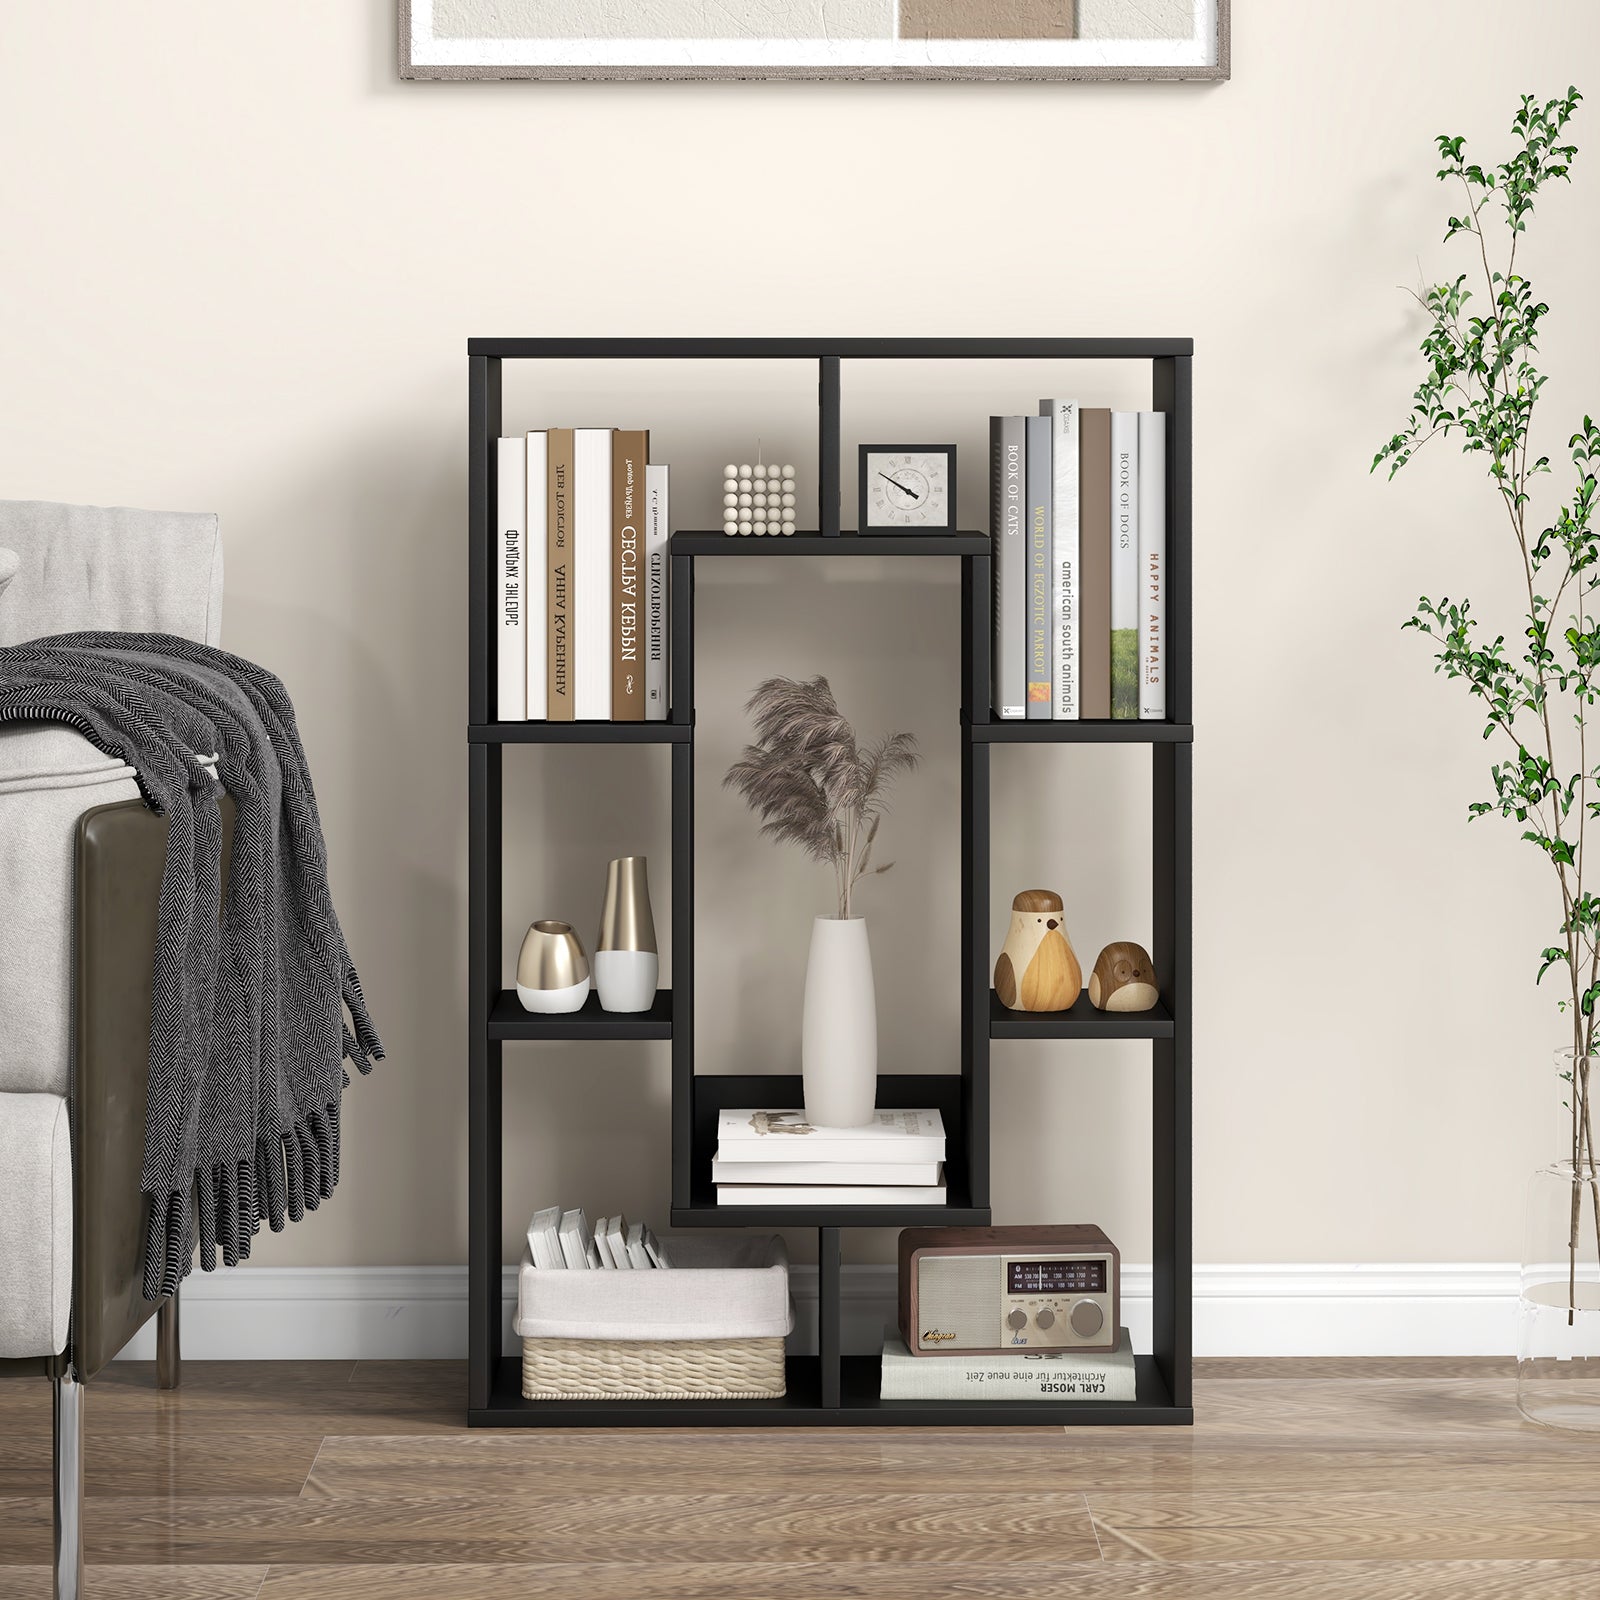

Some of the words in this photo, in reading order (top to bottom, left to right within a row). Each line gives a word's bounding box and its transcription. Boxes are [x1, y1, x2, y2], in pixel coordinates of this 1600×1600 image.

[1007, 445, 1019, 480] BOOK
[1120, 453, 1130, 488] BOOK
[1007, 484, 1019, 501] OF
[1120, 492, 1130, 510] OF
[1007, 505, 1019, 536] CATS
[1034, 505, 1045, 549] WORLD
[1120, 514, 1130, 549] DOGS
[1034, 552, 1045, 569] OF
[1061, 561, 1075, 621] american
[1150, 553, 1160, 602] HAPPY
[1034, 573, 1045, 625] EGZOTIC
[1034, 630, 1045, 675] PARROT
[1061, 624, 1075, 660] south
[1150, 614, 1160, 684] ANIMALS
[1061, 663, 1075, 714] animals
[966, 1371, 985, 1383] Zeit
[987, 1371, 1011, 1380] neue
[1013, 1371, 1034, 1382] eine
[1035, 1372, 1050, 1382] für
[1040, 1383, 1076, 1393] MOSER
[1052, 1372, 1106, 1382] Architektur
[1079, 1383, 1106, 1394] CARL
